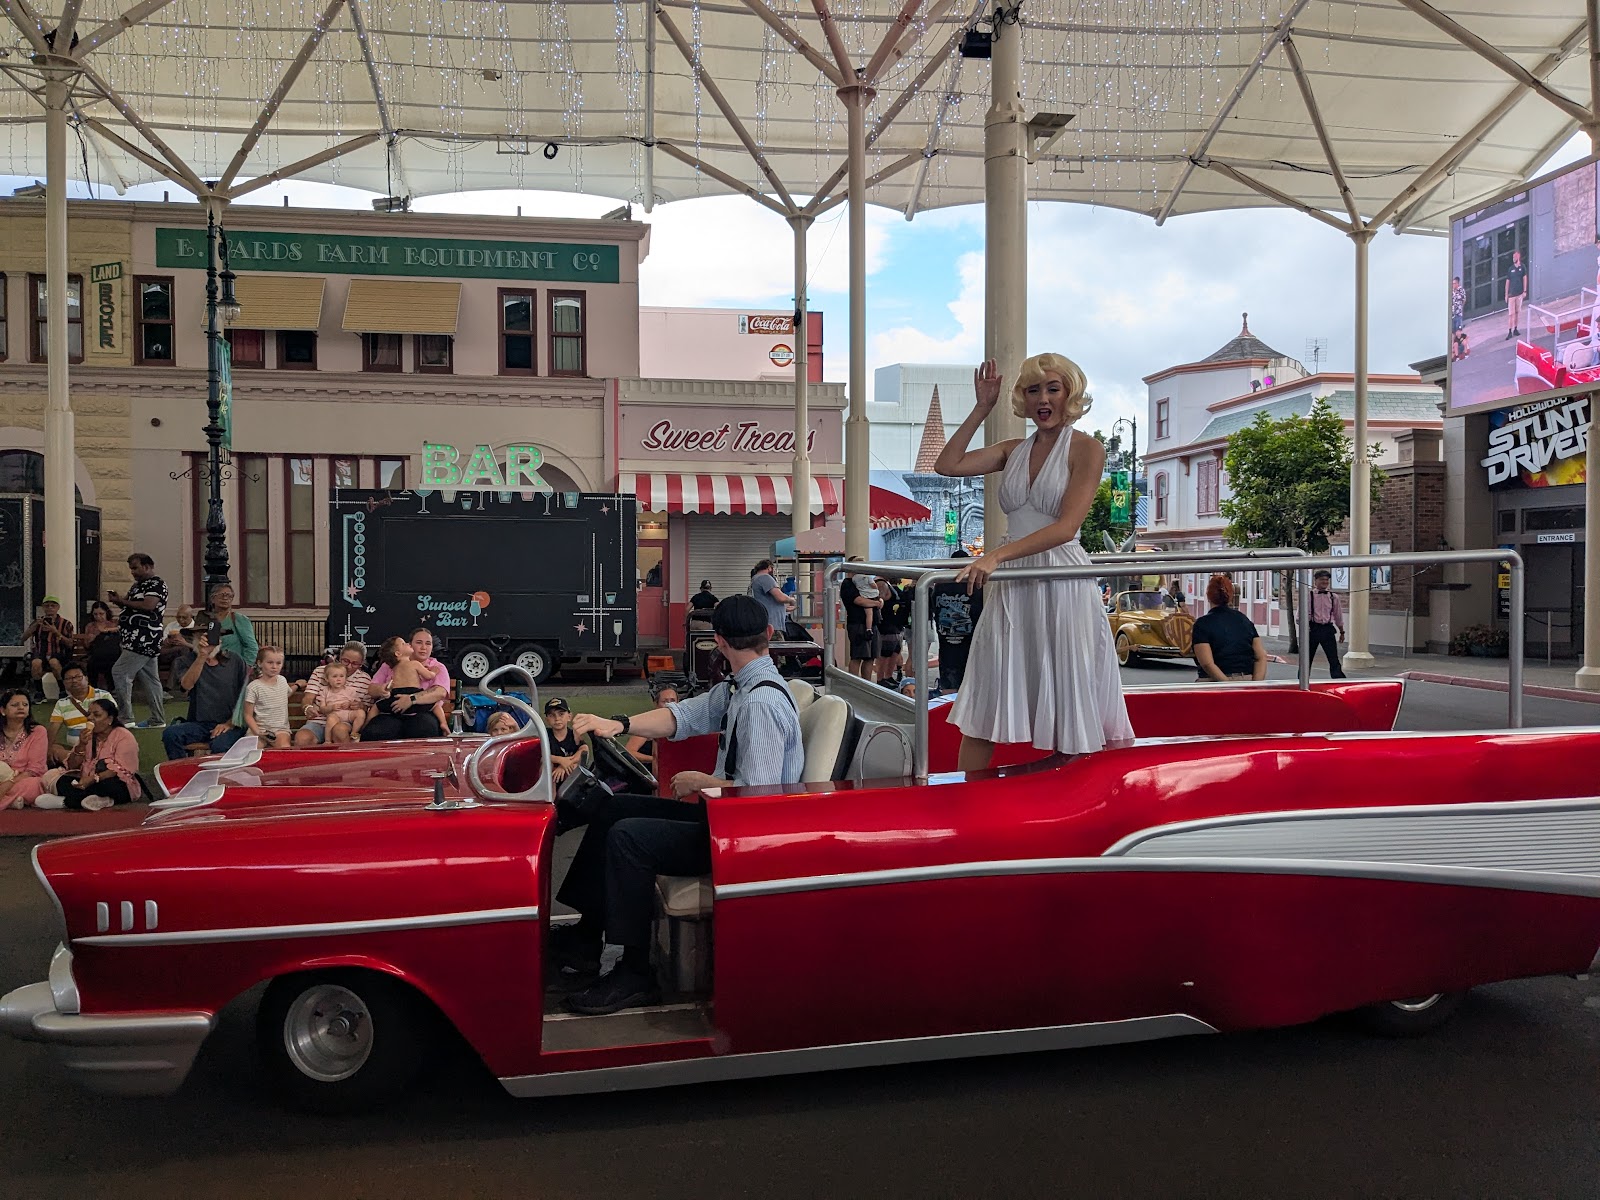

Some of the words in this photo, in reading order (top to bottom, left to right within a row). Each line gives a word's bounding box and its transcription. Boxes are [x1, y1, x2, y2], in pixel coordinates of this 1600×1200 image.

[226, 240, 303, 261] ARDS
[317, 243, 390, 264] FARM
[404, 246, 559, 270] EQUIPMENT
[92, 264, 120, 282] LAND
[642, 418, 731, 452] Sweet
[731, 421, 816, 453] Treas
[1488, 399, 1589, 456] STUNT
[421, 443, 547, 486] BAR
[354, 511, 365, 588] WELCOME
[1539, 534, 1574, 542] ENTRANCE
[365, 604, 376, 613] to
[416, 595, 468, 611] Sunset
[436, 611, 468, 627] Bar
